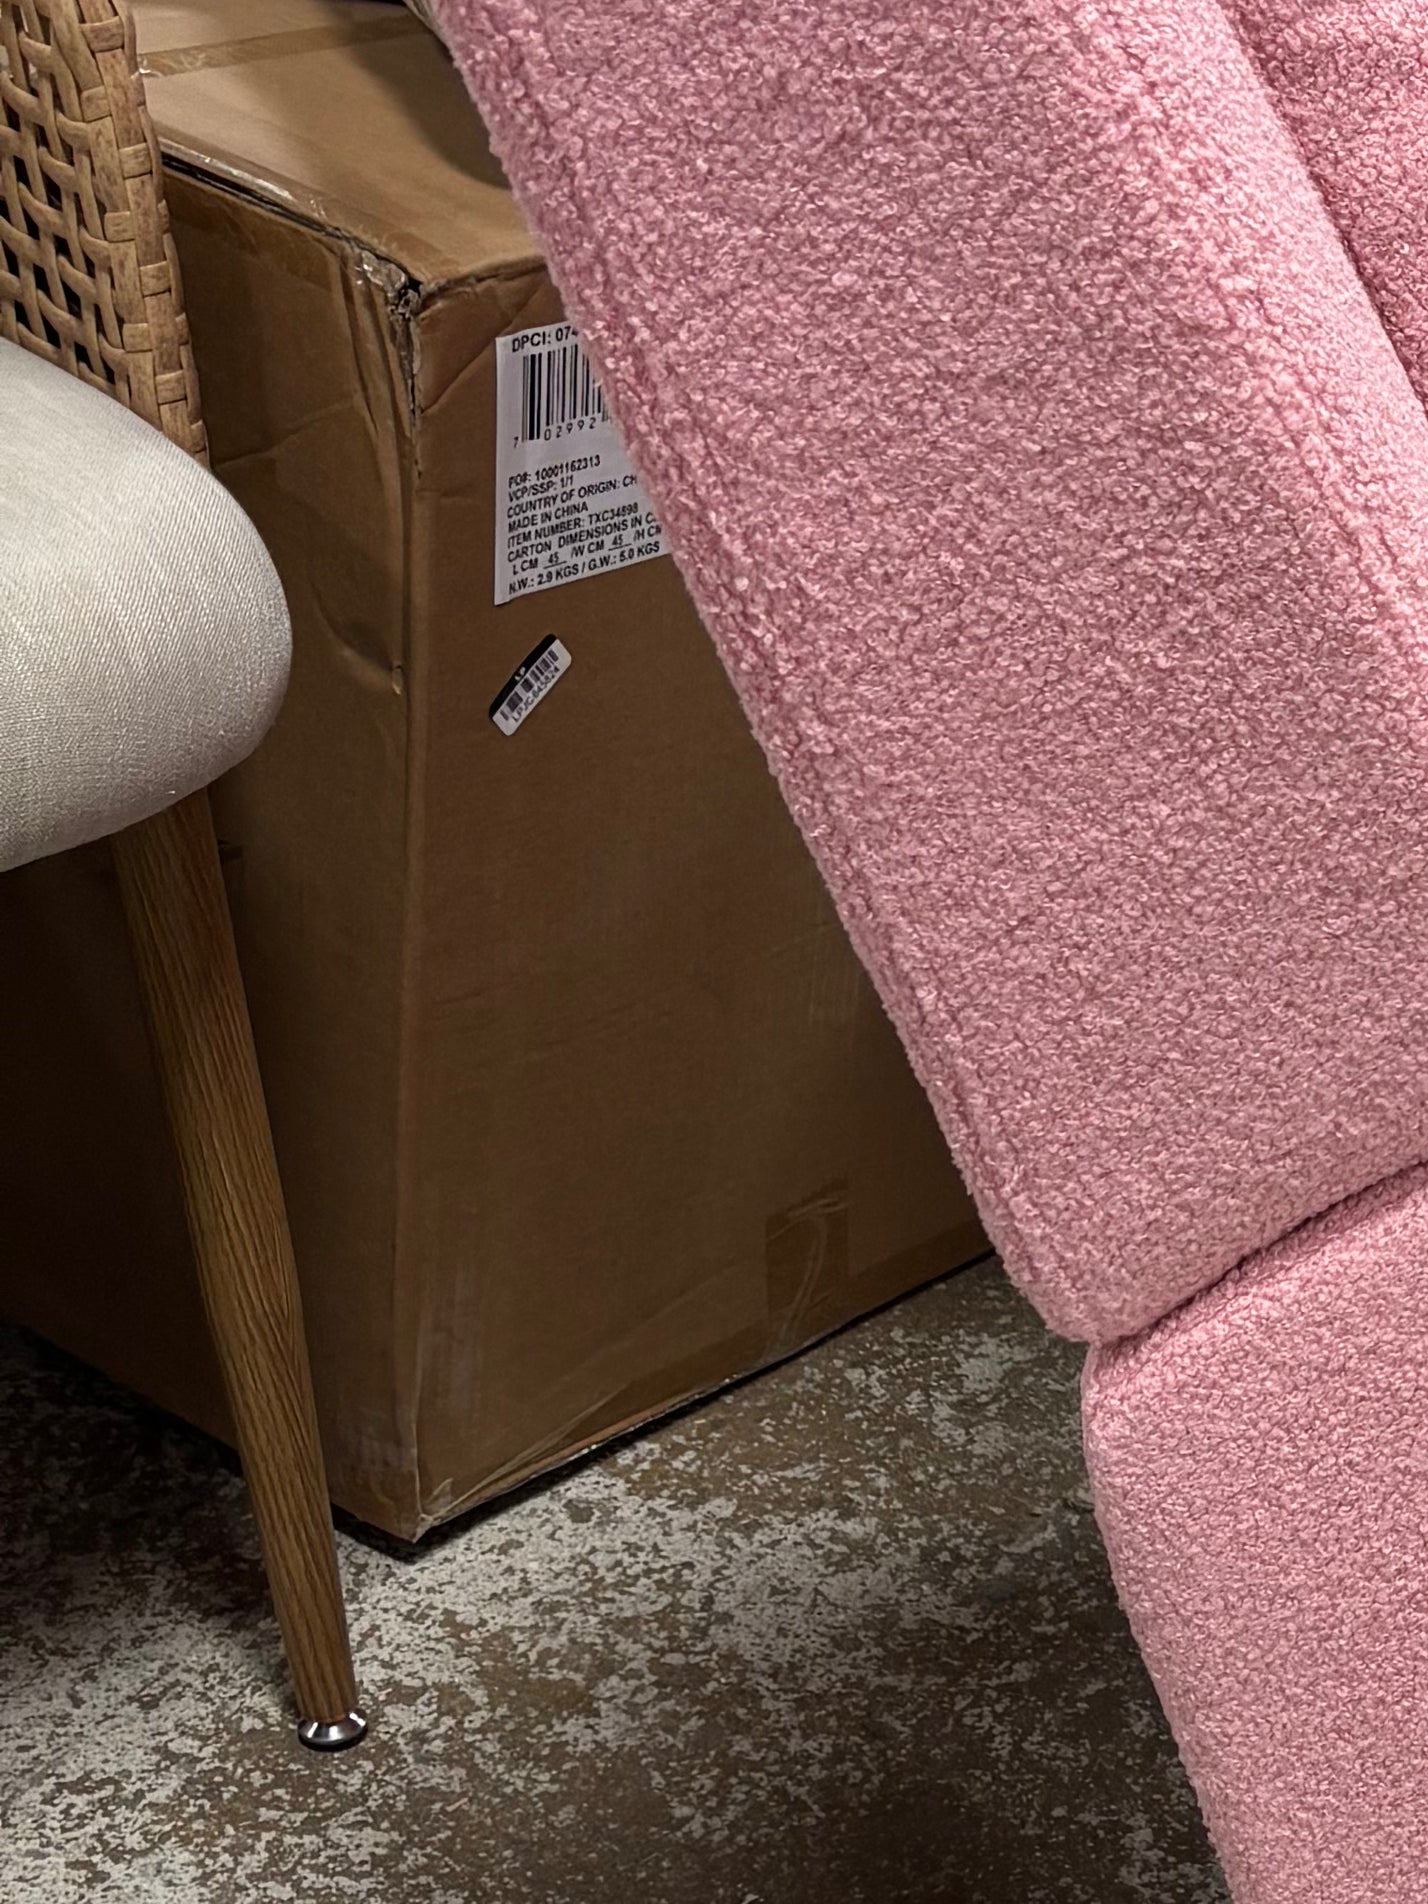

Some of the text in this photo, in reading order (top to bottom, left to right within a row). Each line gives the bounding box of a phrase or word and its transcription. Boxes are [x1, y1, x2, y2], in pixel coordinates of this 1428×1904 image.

[512, 331, 551, 353] DPCI:
[560, 475, 574, 489] 1/1
[507, 492, 557, 519] COUNTRY
[561, 488, 576, 504] OF
[578, 479, 620, 499] ORIGIN:
[507, 531, 532, 549] ITEM
[534, 517, 585, 541] NUMBER:
[508, 501, 588, 533] MADE IN CHINA
[507, 540, 552, 563] CARTON
[558, 519, 628, 549] DIMENSIONS
[630, 515, 642, 529] IN
[520, 558, 539, 572] CM
[587, 540, 605, 555] CM
[555, 563, 579, 581] KGS
[637, 541, 660, 557] KGS
